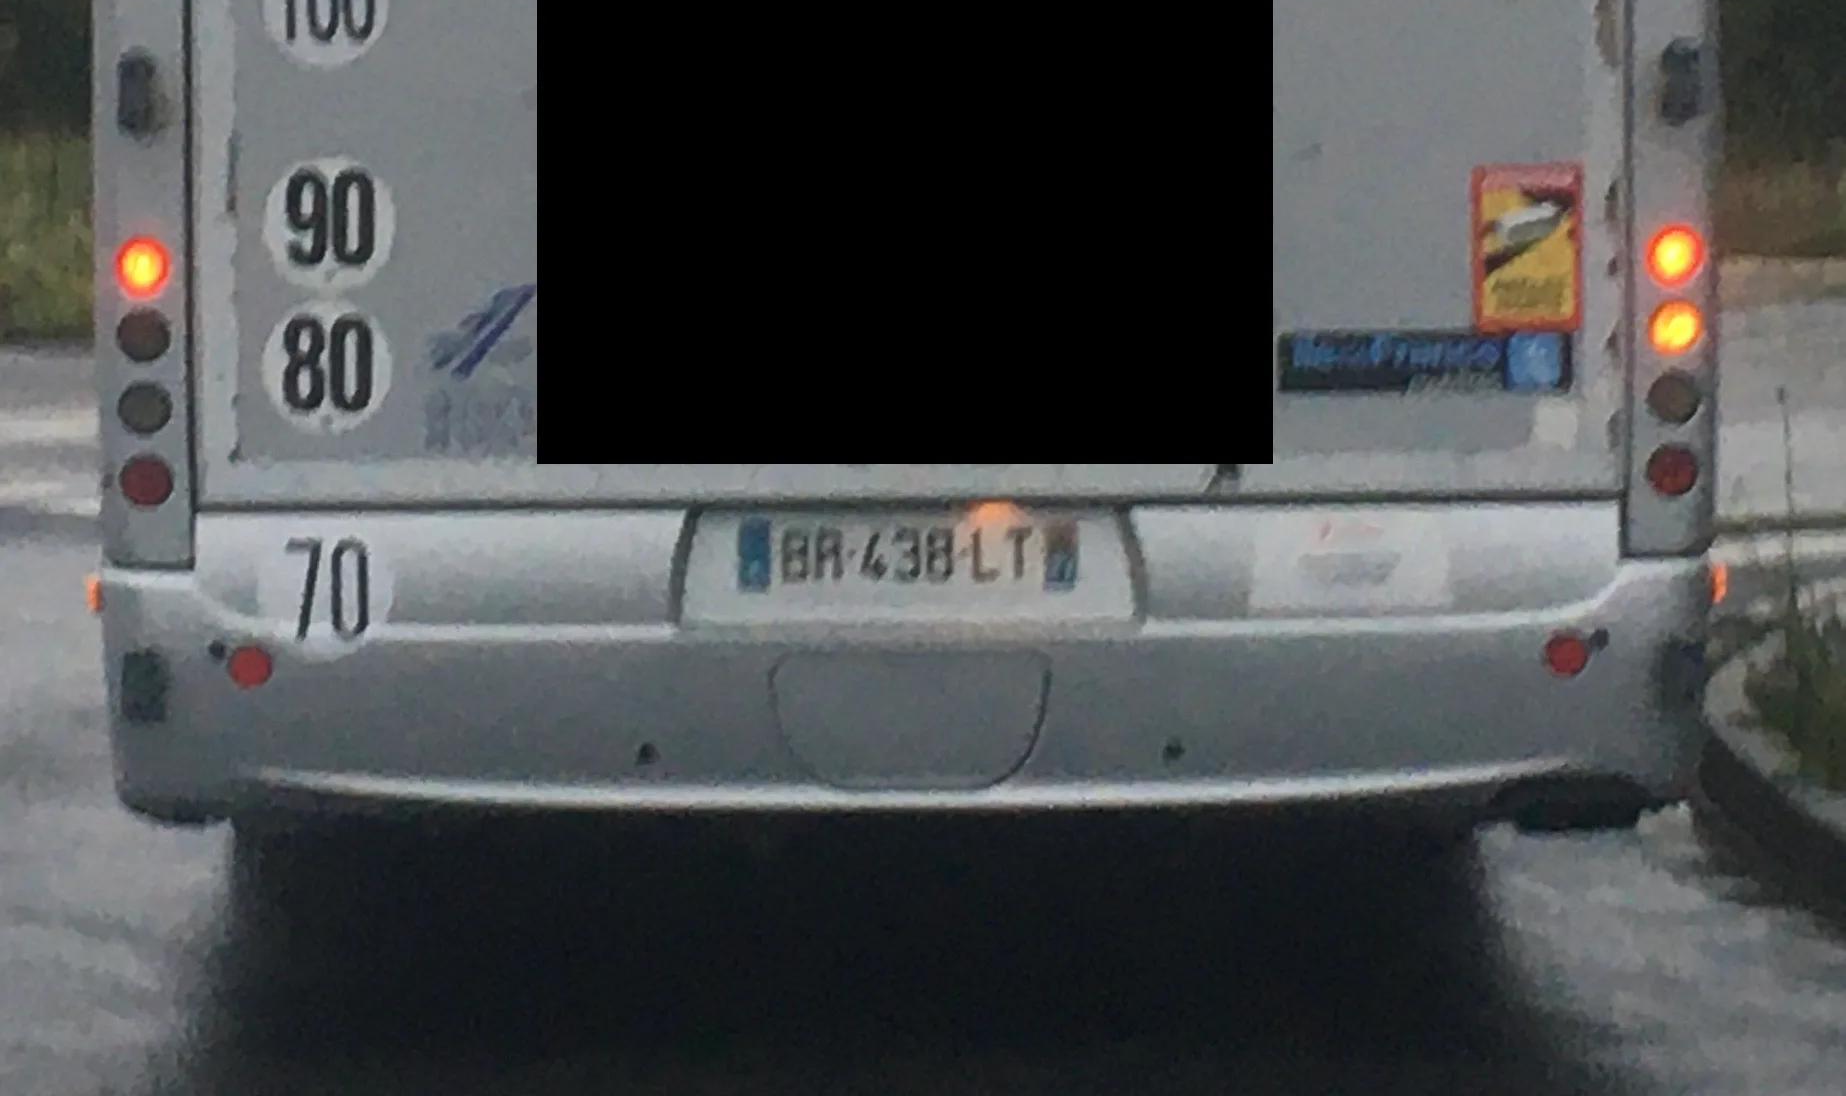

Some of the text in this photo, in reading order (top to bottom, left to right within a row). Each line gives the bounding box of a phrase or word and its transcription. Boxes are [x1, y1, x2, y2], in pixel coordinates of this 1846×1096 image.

[284, 165, 376, 265] 90
[282, 312, 374, 414] 80
[285, 534, 369, 643] 70
